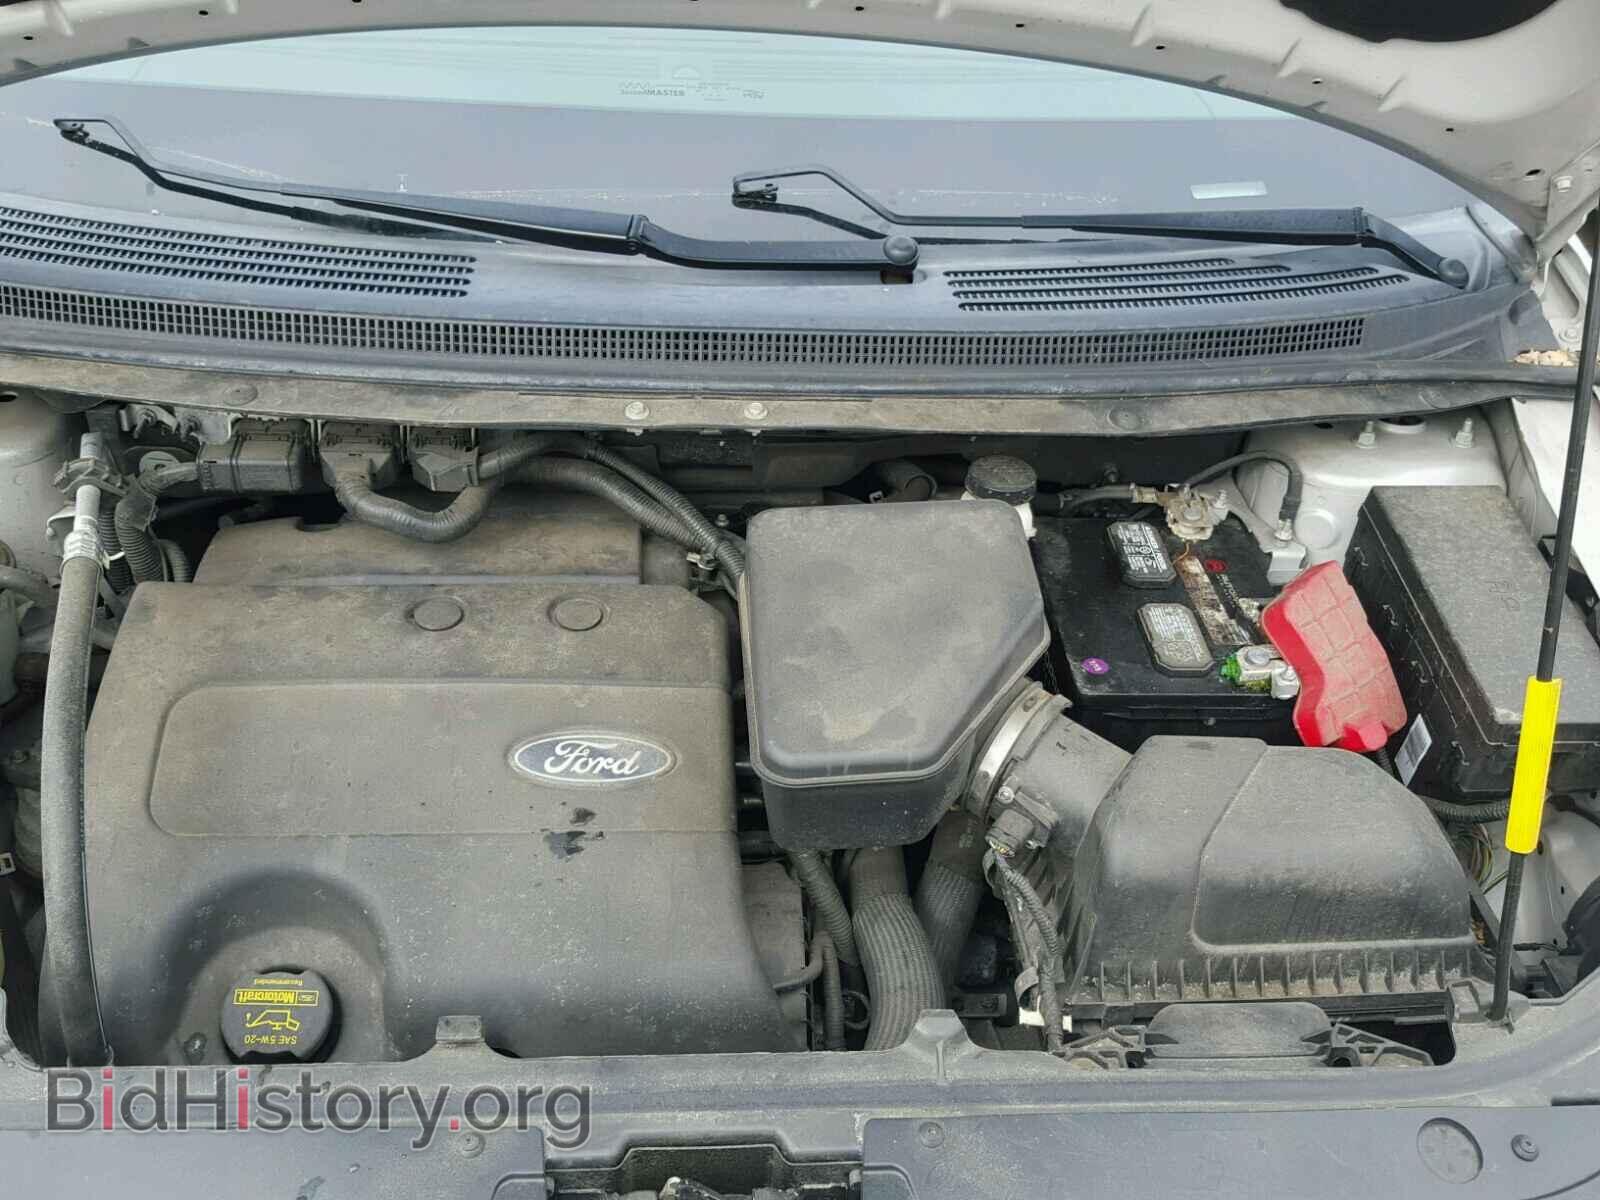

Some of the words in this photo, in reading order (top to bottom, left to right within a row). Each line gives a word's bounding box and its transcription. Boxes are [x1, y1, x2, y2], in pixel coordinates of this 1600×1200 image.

[544, 740, 641, 775] Ford
[238, 991, 295, 1003] Motorcraft
[244, 1034, 276, 1044] 5W-20
[279, 1035, 297, 1044] SAE
